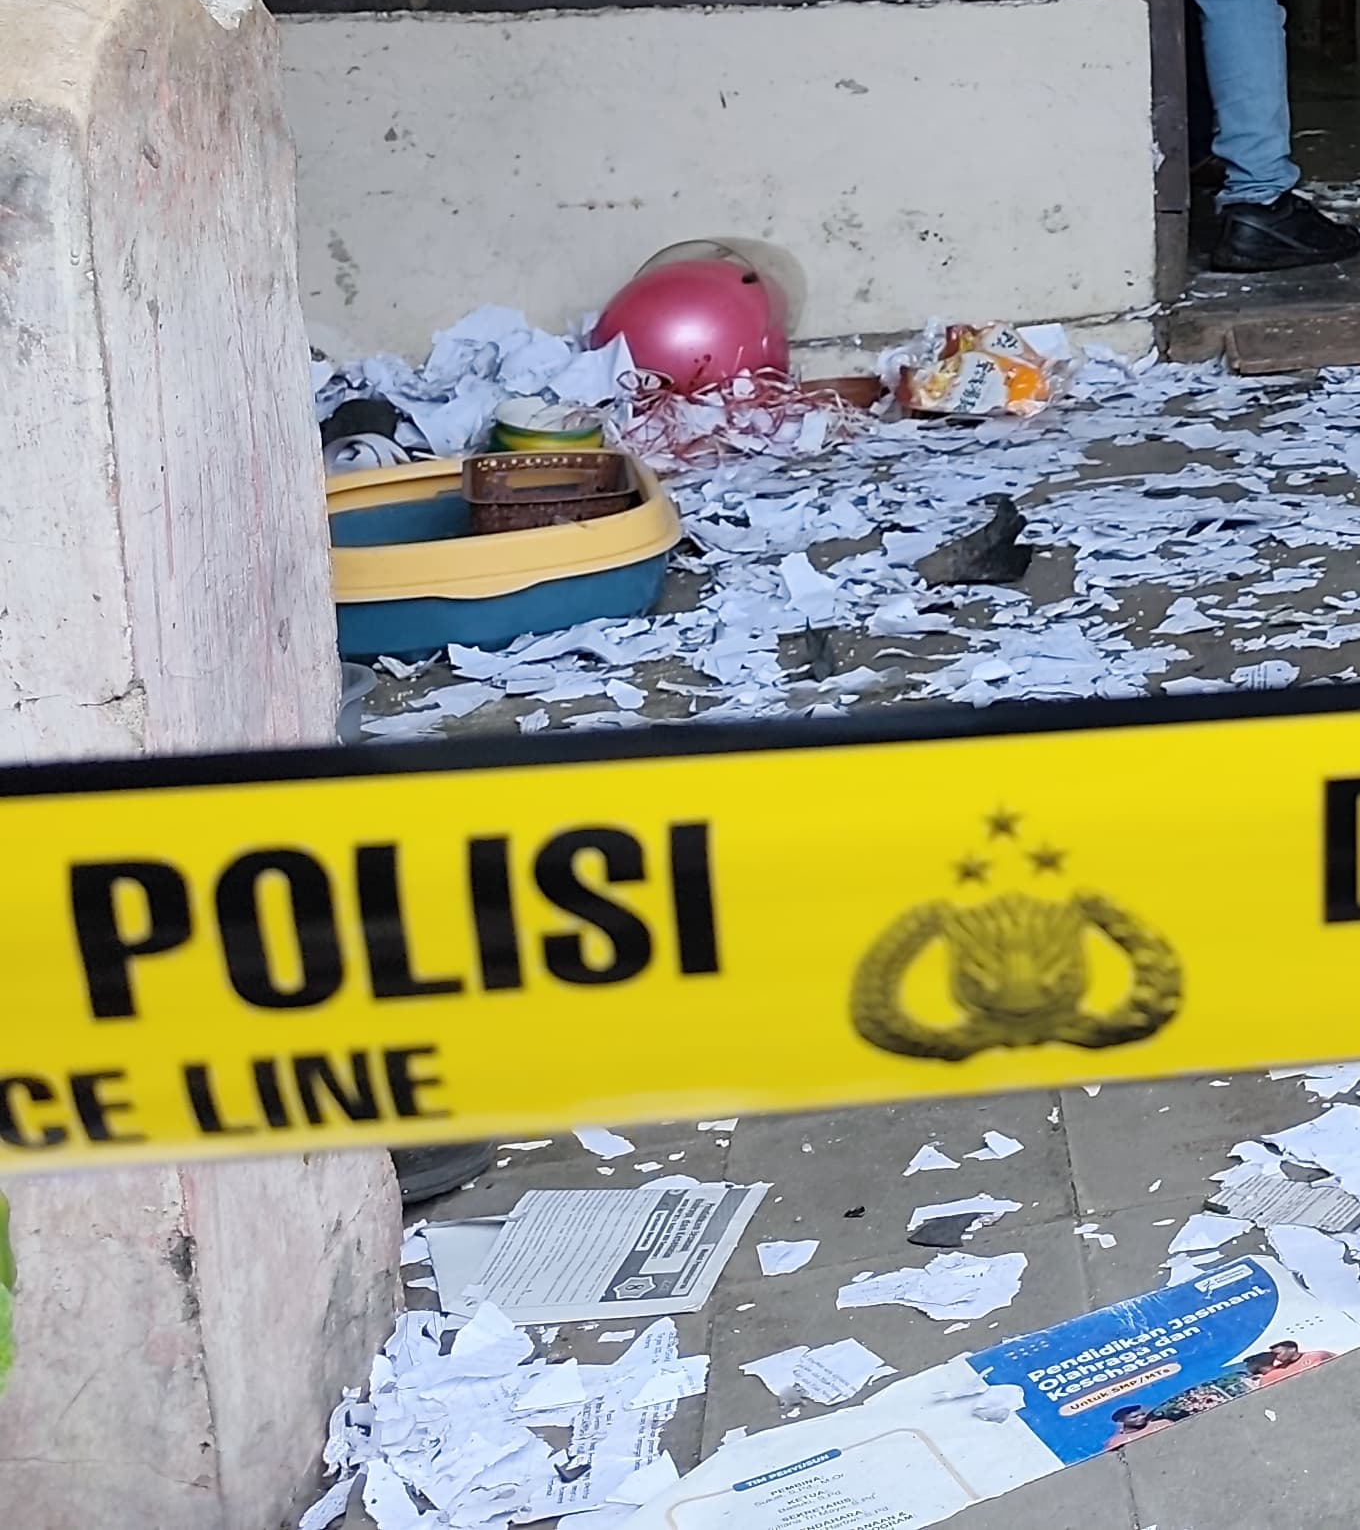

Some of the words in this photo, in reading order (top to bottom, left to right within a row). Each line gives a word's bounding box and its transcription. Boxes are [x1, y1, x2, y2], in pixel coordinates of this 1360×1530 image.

[68, 821, 722, 1022] POLISI
[181, 1044, 452, 1135] LINE
[1027, 1327, 1167, 1383] Pendidikan
[1038, 1345, 1152, 1391] Olahraga
[1154, 1326, 1201, 1347] dan
[1046, 1347, 1179, 1402] Kesehatan
[1069, 1391, 1109, 1411] Untuk
[746, 1476, 768, 1487] TIM
[768, 1453, 830, 1480] PENYUSUN
